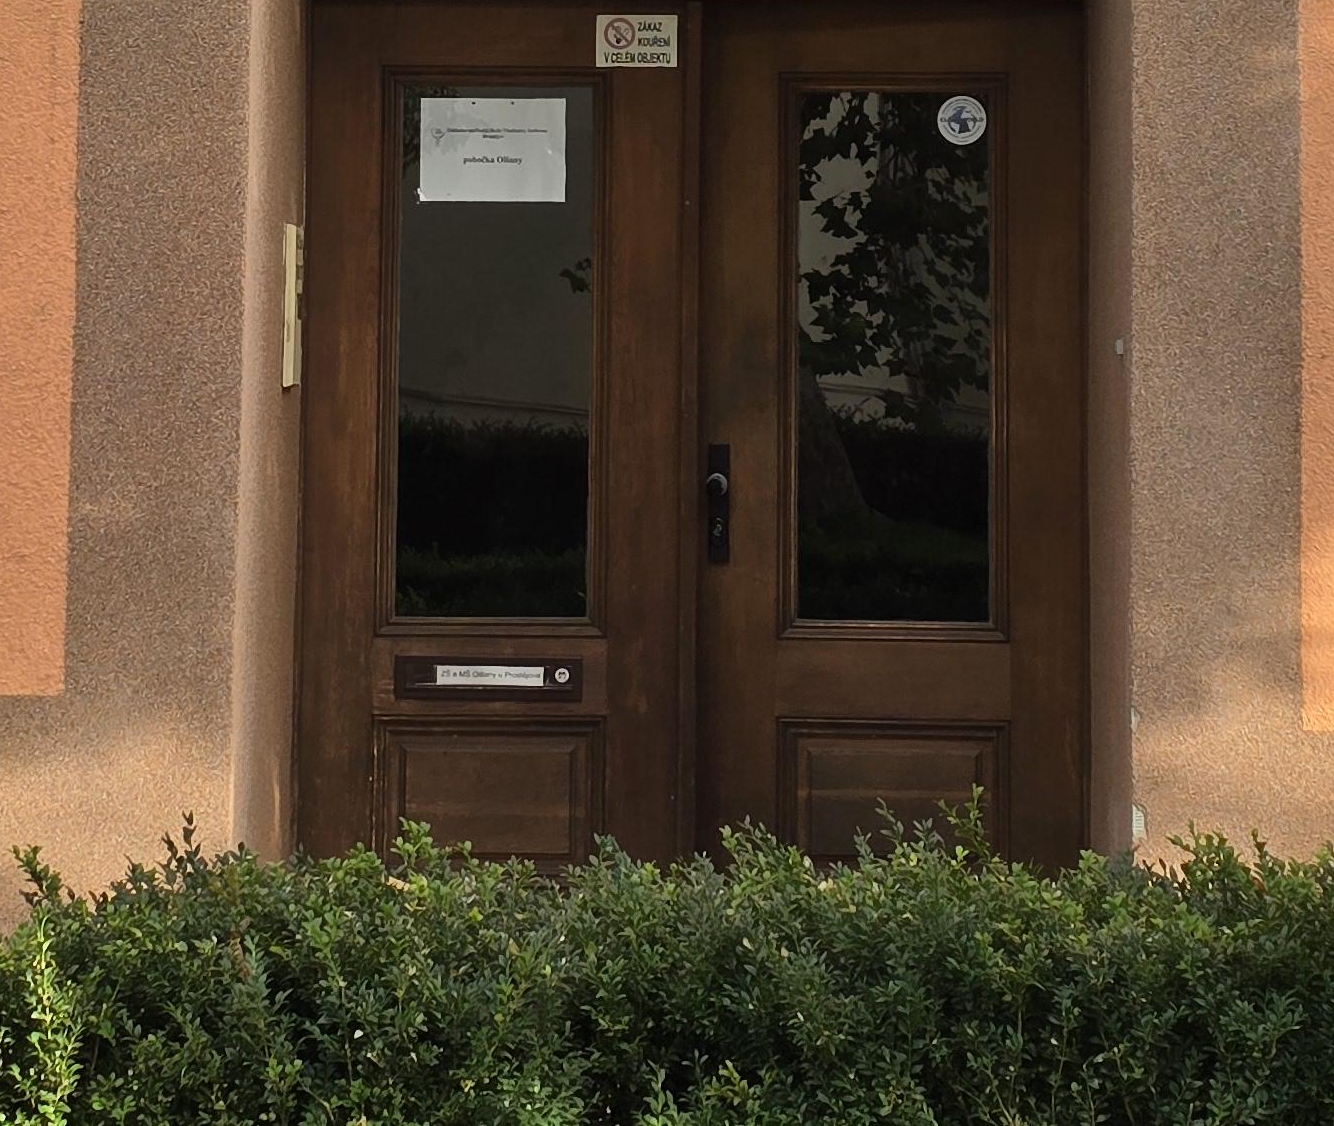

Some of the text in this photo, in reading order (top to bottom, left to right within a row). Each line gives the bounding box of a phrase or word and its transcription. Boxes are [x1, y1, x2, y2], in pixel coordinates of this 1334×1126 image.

[637, 21, 662, 32] ZÁKAZ
[637, 35, 670, 47] KOUŘENÍ
[604, 50, 671, 64] V CELÉM OBJEKTU
